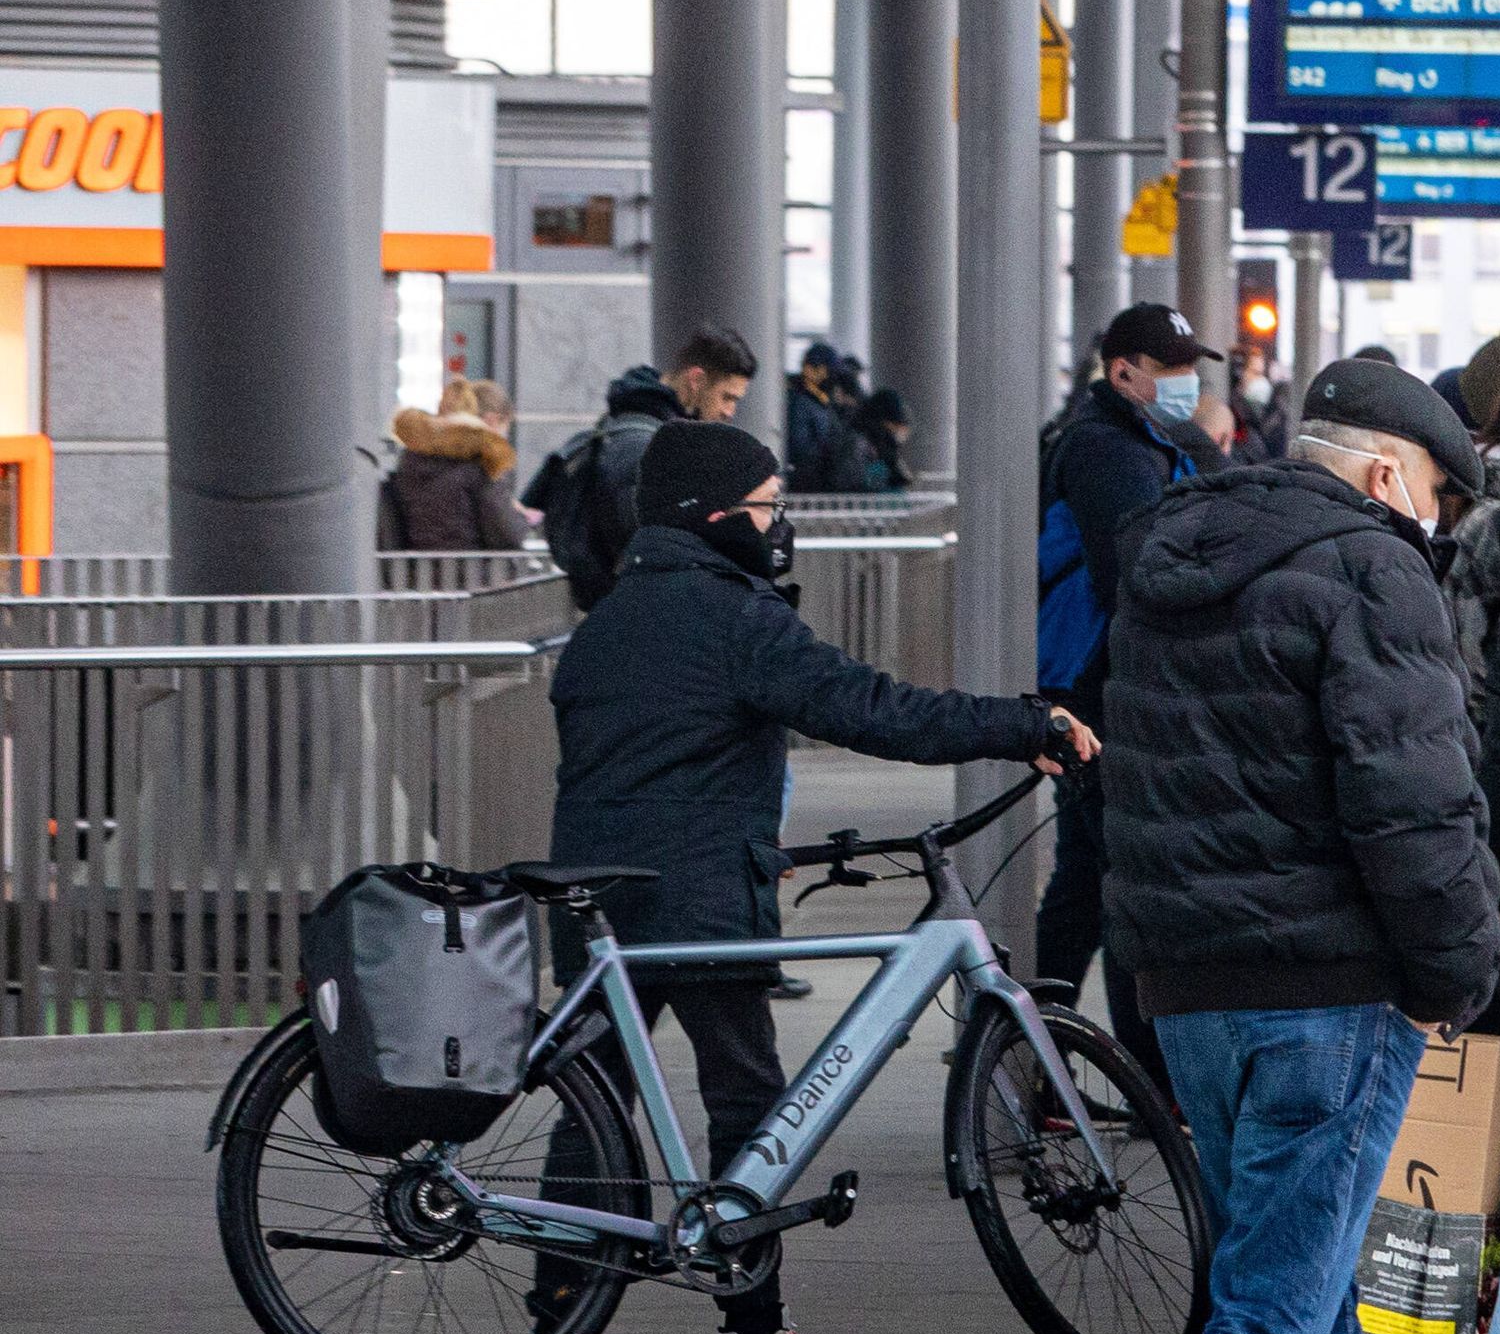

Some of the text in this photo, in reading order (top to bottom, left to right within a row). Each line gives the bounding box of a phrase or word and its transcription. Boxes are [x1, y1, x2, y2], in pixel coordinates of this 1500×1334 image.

[0, 107, 165, 193] OO
[1288, 136, 1368, 204] 12
[1363, 230, 1409, 267] 12
[775, 1044, 853, 1130] Dance
